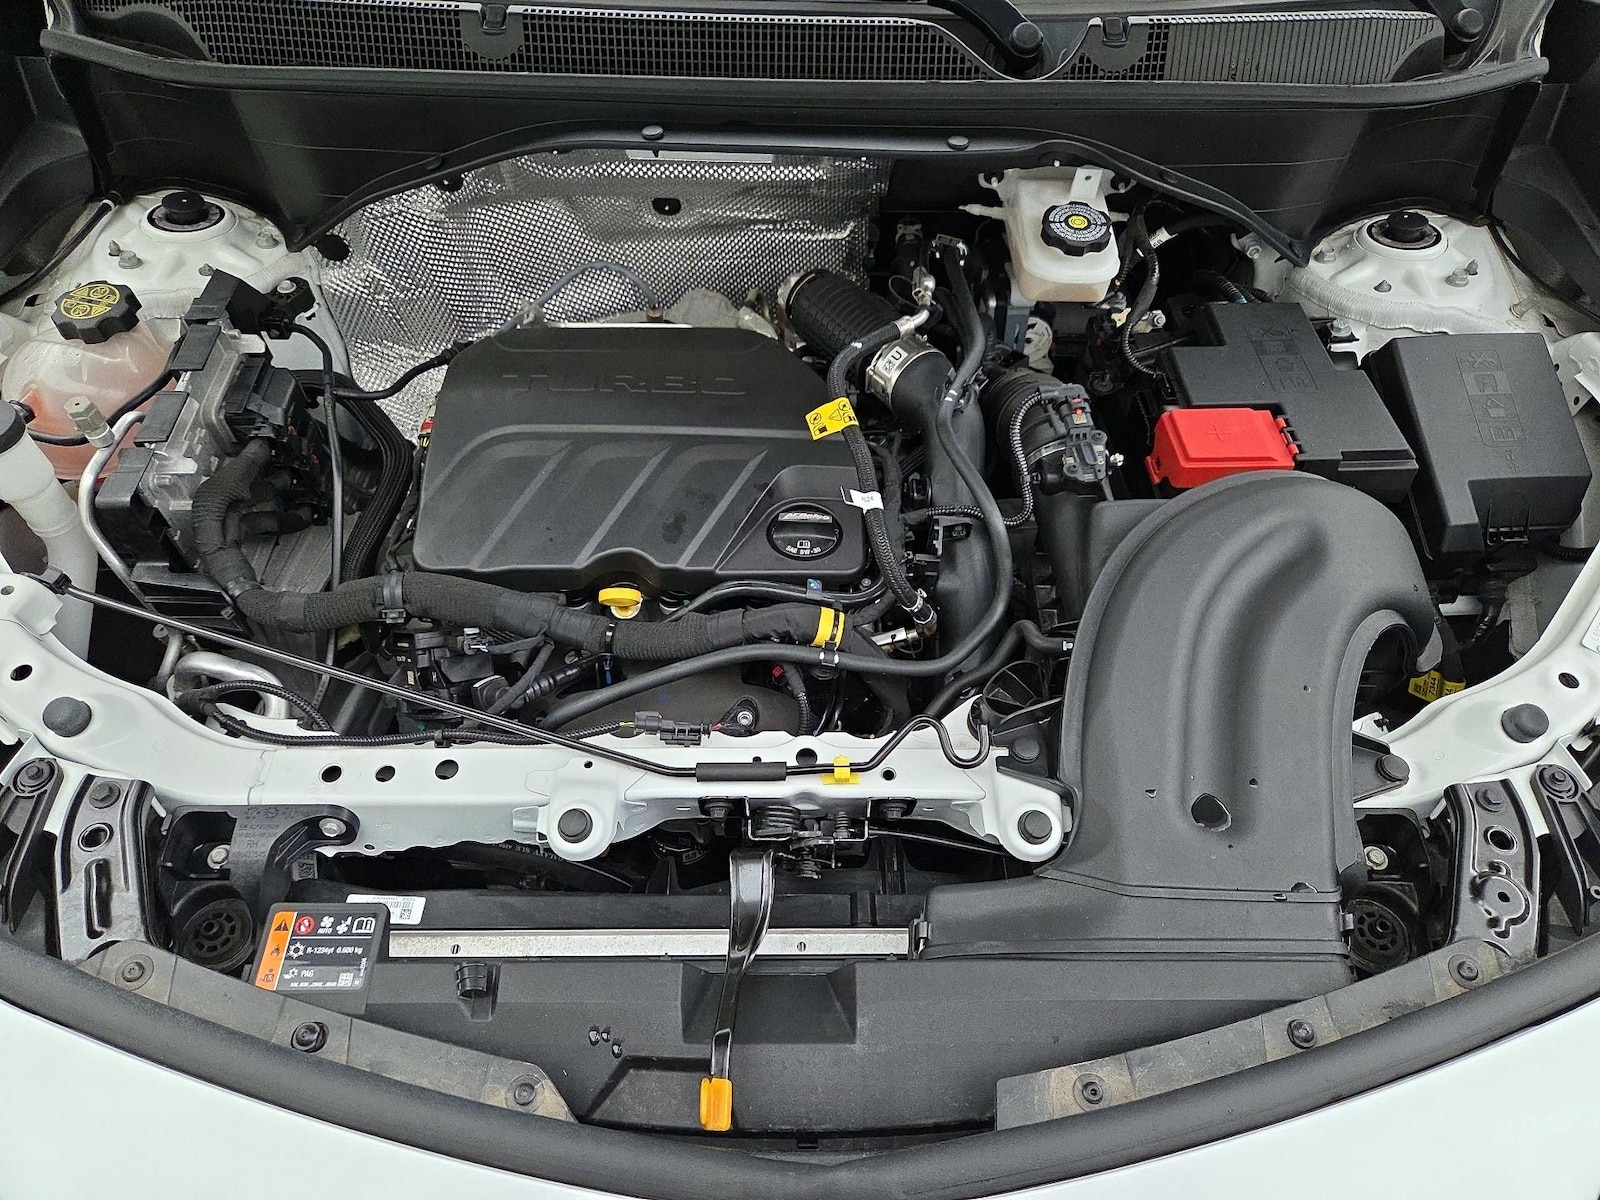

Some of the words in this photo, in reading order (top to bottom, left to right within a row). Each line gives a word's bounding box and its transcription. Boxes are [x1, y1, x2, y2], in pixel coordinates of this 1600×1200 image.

[891, 350, 902, 361] U
[502, 374, 747, 395] TURBO
[782, 512, 831, 520] ACDelco
[354, 946, 363, 955] kg
[300, 969, 314, 978] PAG
